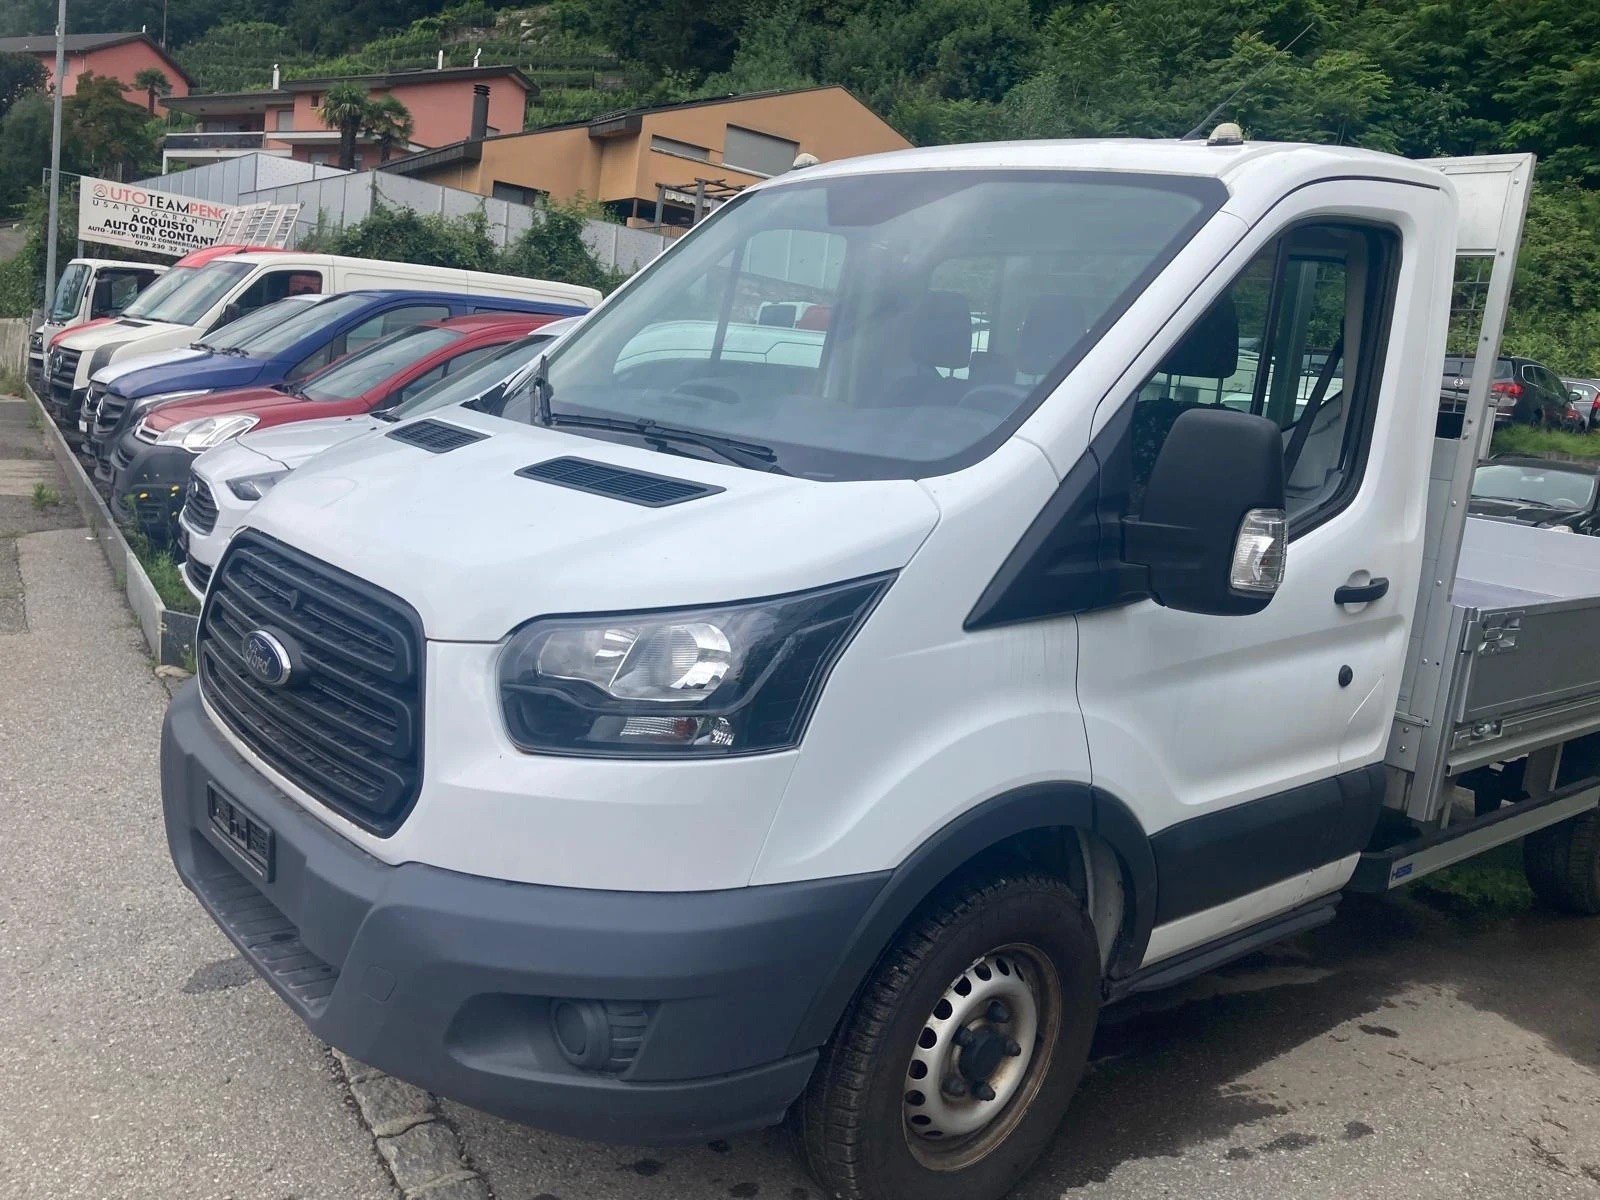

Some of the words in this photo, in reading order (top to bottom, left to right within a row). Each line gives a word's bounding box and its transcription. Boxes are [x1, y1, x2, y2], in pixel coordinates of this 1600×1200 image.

[92, 199, 140, 213] USATO
[151, 210, 219, 228] GARANTIT
[131, 214, 195, 233] ACQUISTO
[88, 225, 105, 233] AUTO
[131, 233, 157, 242] VEICOLI
[104, 218, 138, 232] AUTO
[142, 225, 155, 236] IN
[159, 229, 214, 246] CONTANT
